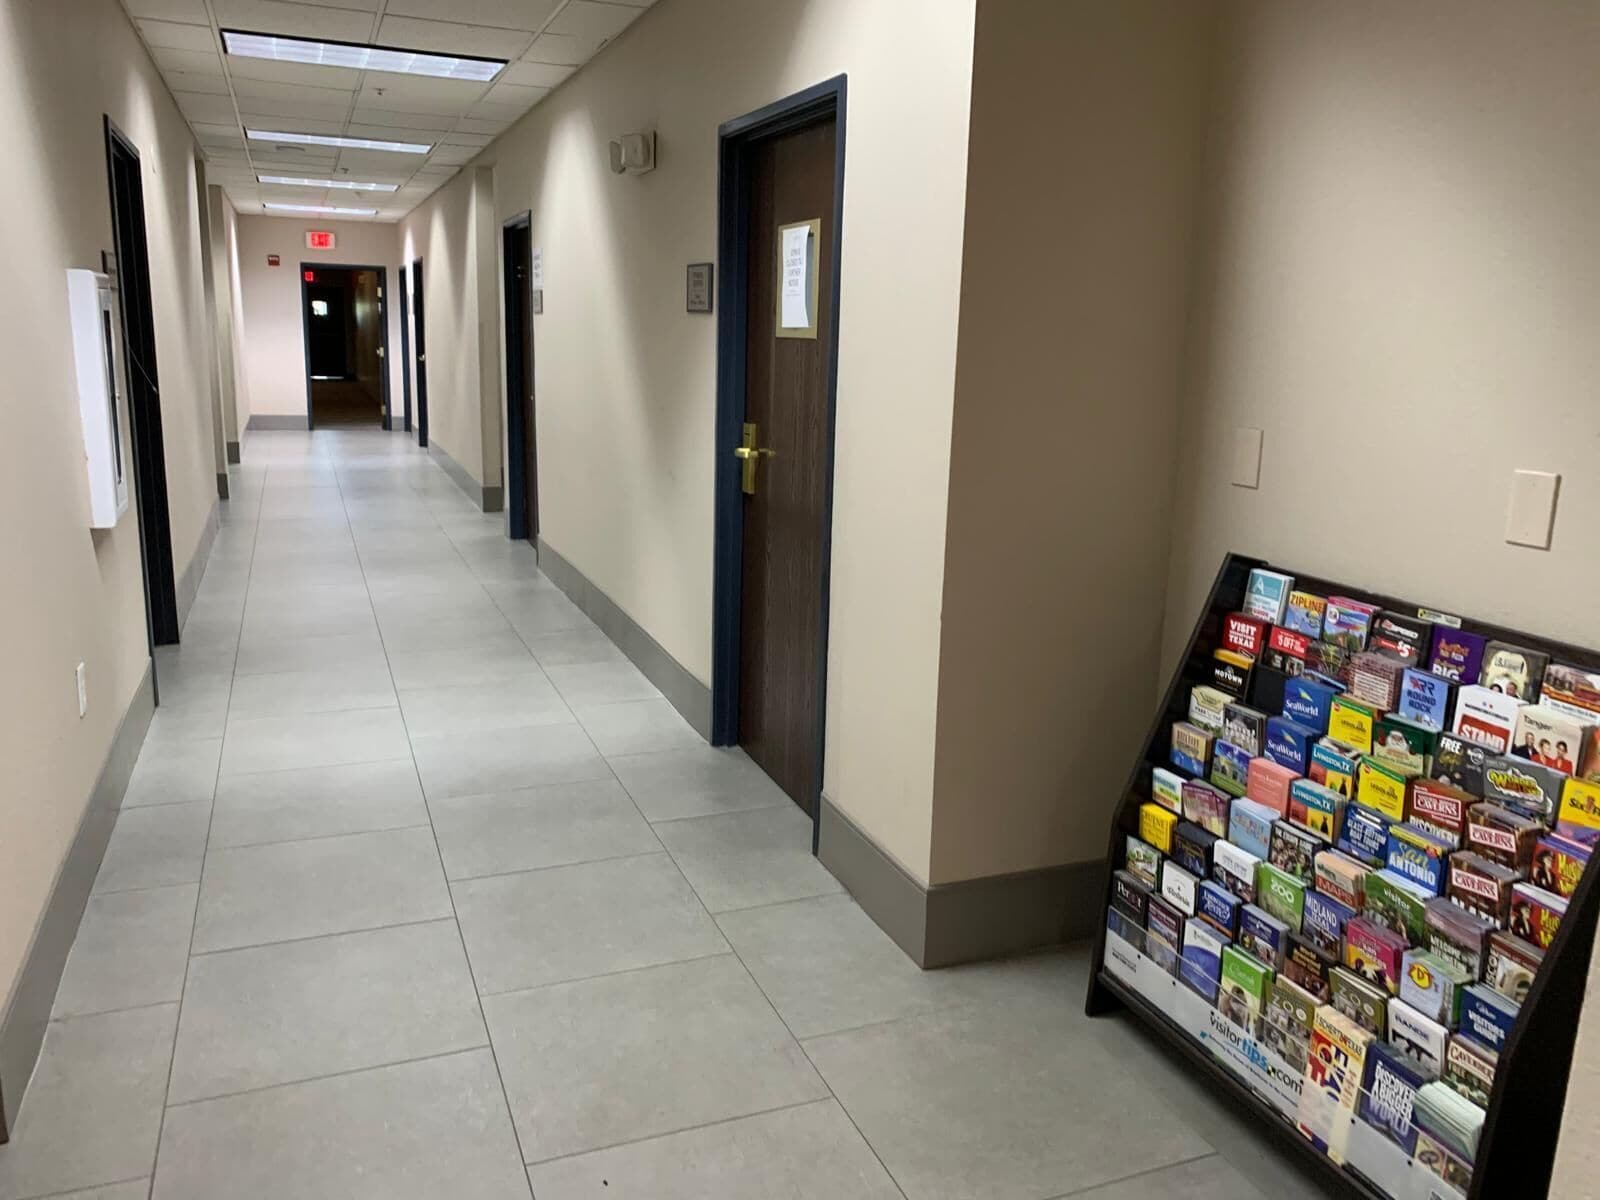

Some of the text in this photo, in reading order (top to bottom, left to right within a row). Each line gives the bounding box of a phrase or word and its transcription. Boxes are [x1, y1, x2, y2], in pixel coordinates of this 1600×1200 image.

[1290, 594, 1324, 613] ZIPLINE
[1230, 620, 1257, 635] VISIT
[1229, 635, 1254, 649] TEXAS
[1432, 664, 1460, 680] BIG
[1286, 699, 1319, 717] SeaWorld
[1407, 690, 1437, 706] ROUND
[1408, 700, 1432, 714] ROCK
[1523, 714, 1553, 731] Tanger
[1441, 736, 1463, 754] FREE
[1460, 723, 1505, 750] STAND
[1267, 739, 1301, 762] SeaWorld
[1417, 799, 1458, 816] CAVERNS
[1409, 816, 1459, 847] DISCOVERY
[1472, 829, 1513, 849] CAVERNS
[1399, 841, 1429, 868] San
[1389, 852, 1436, 886] ANTONIO
[1317, 878, 1353, 906] MAPS
[1455, 873, 1497, 897] CAVERNS
[1306, 894, 1337, 926] MIDLAND
[1271, 996, 1307, 1021] ZOO
[1338, 988, 1375, 1016] ZOO
[1474, 1022, 1498, 1045] GUIDE
[1375, 1064, 1415, 1100] DISCOVER
[1380, 1084, 1413, 1123] BIGGER
[1370, 1095, 1410, 1136] WORLD
